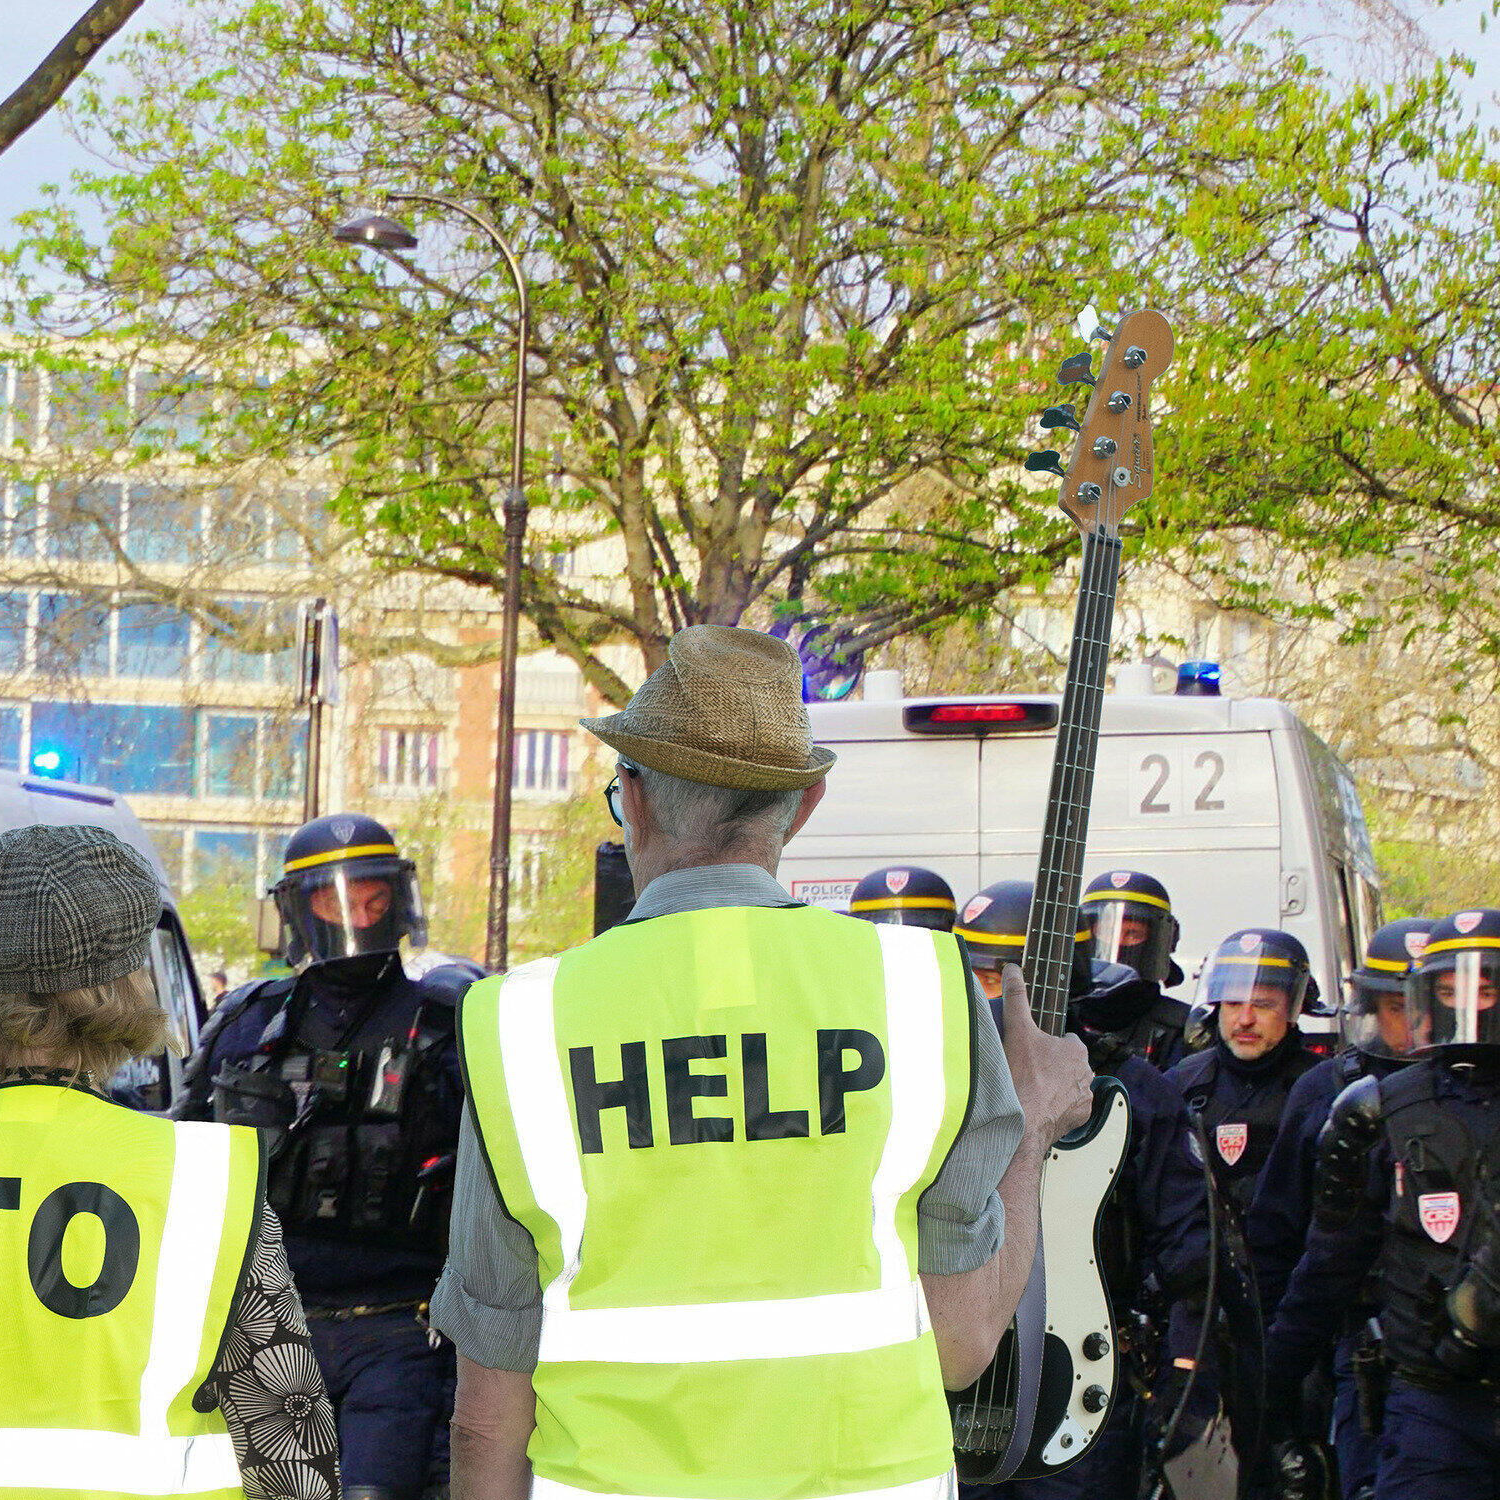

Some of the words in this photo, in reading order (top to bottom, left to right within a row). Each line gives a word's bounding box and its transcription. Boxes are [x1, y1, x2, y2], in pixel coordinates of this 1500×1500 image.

[1140, 750, 1225, 814] 22
[801, 884, 852, 895] POLICE
[568, 1028, 886, 1155] HELP
